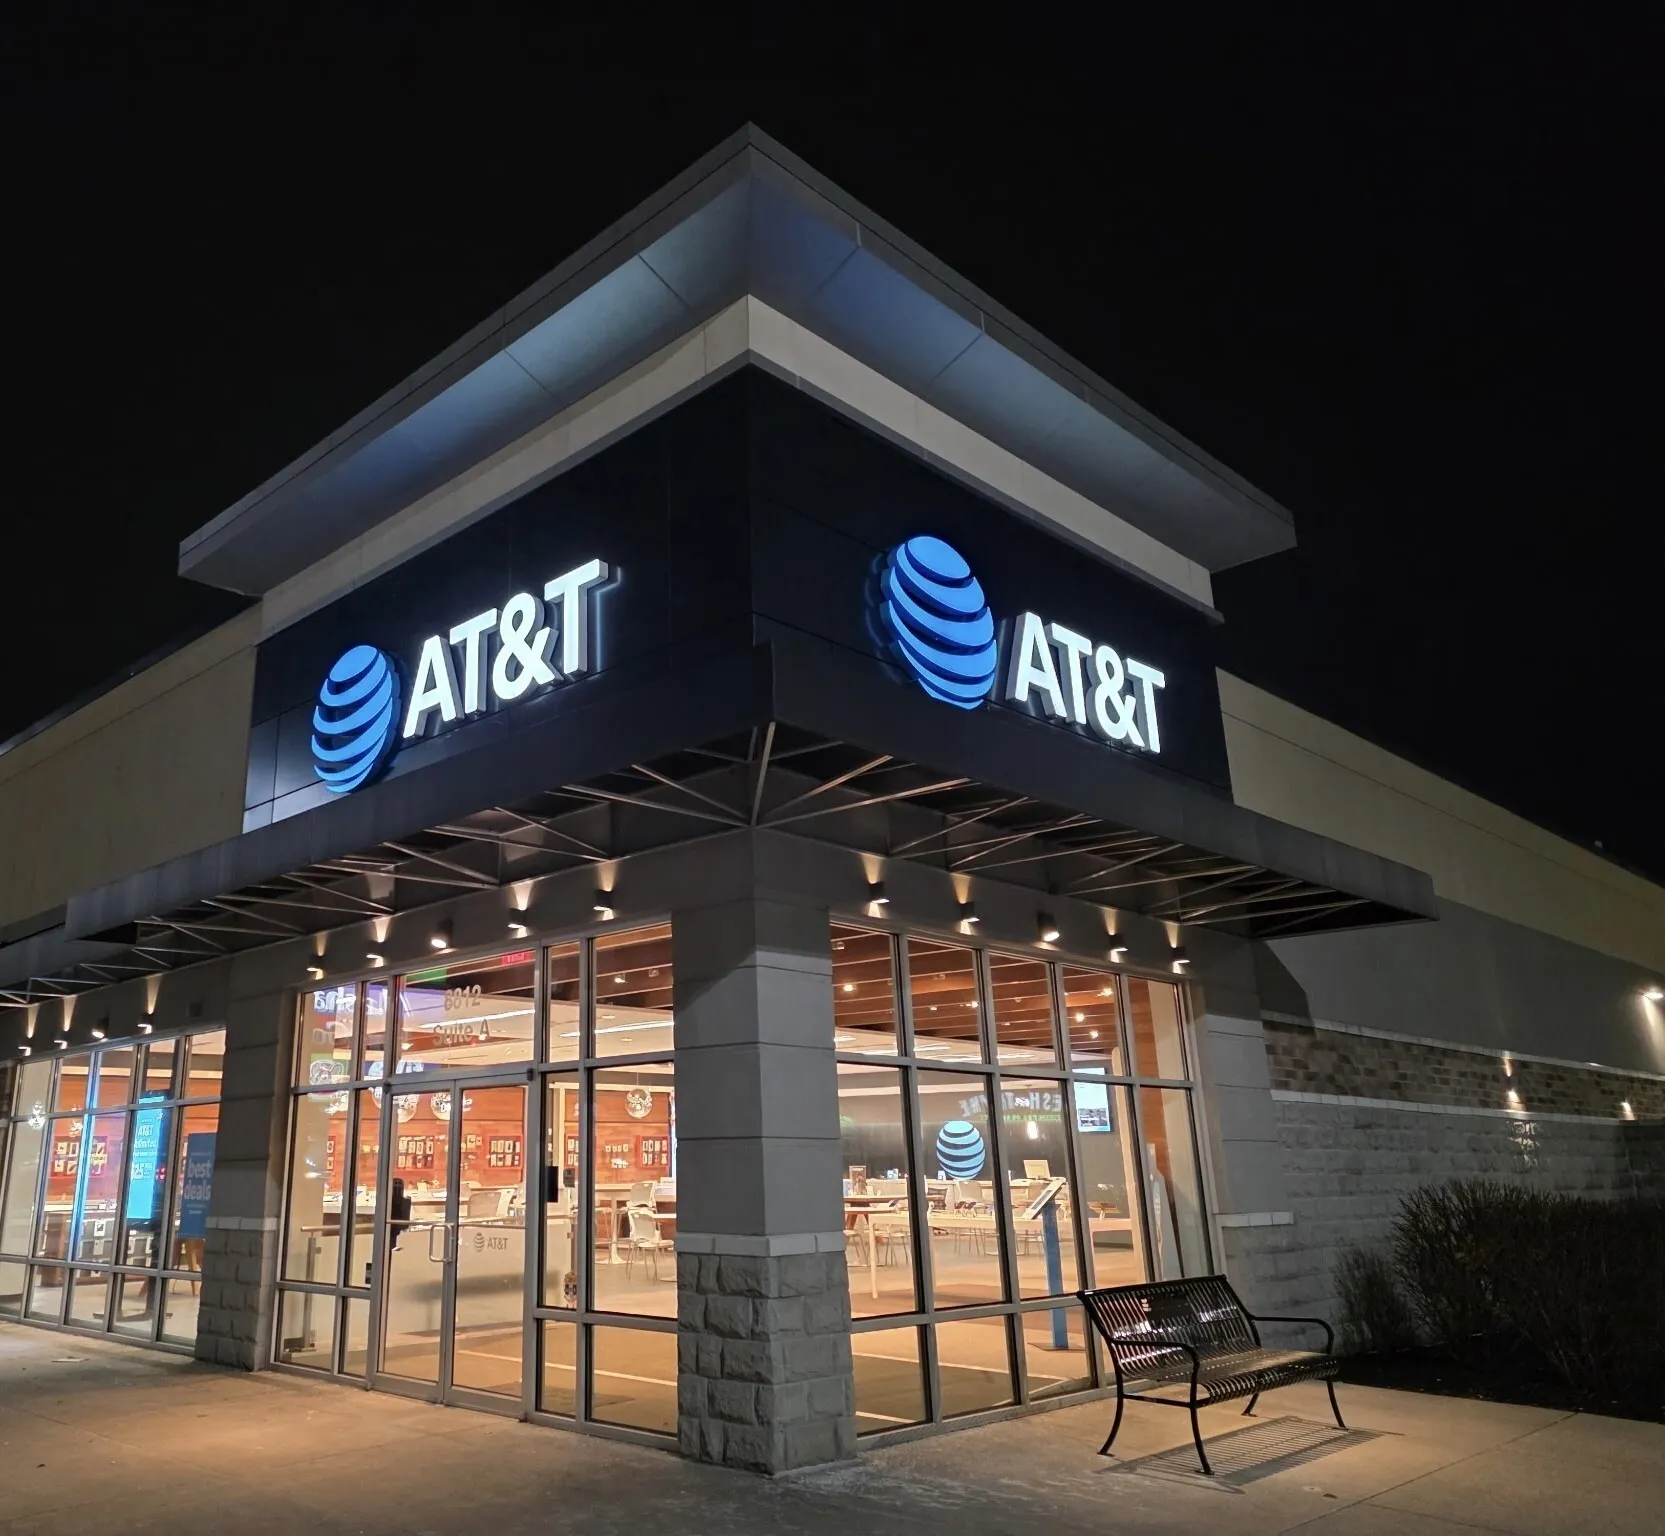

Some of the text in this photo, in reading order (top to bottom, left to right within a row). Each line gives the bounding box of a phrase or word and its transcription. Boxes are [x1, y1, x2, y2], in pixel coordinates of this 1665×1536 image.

[403, 559, 608, 738] AT&T
[1006, 612, 1166, 753] AT&T
[433, 1019, 490, 1047] Suite A
[188, 1160, 212, 1178] best
[184, 1180, 212, 1200] deals
[487, 1237, 508, 1250] AT&T
